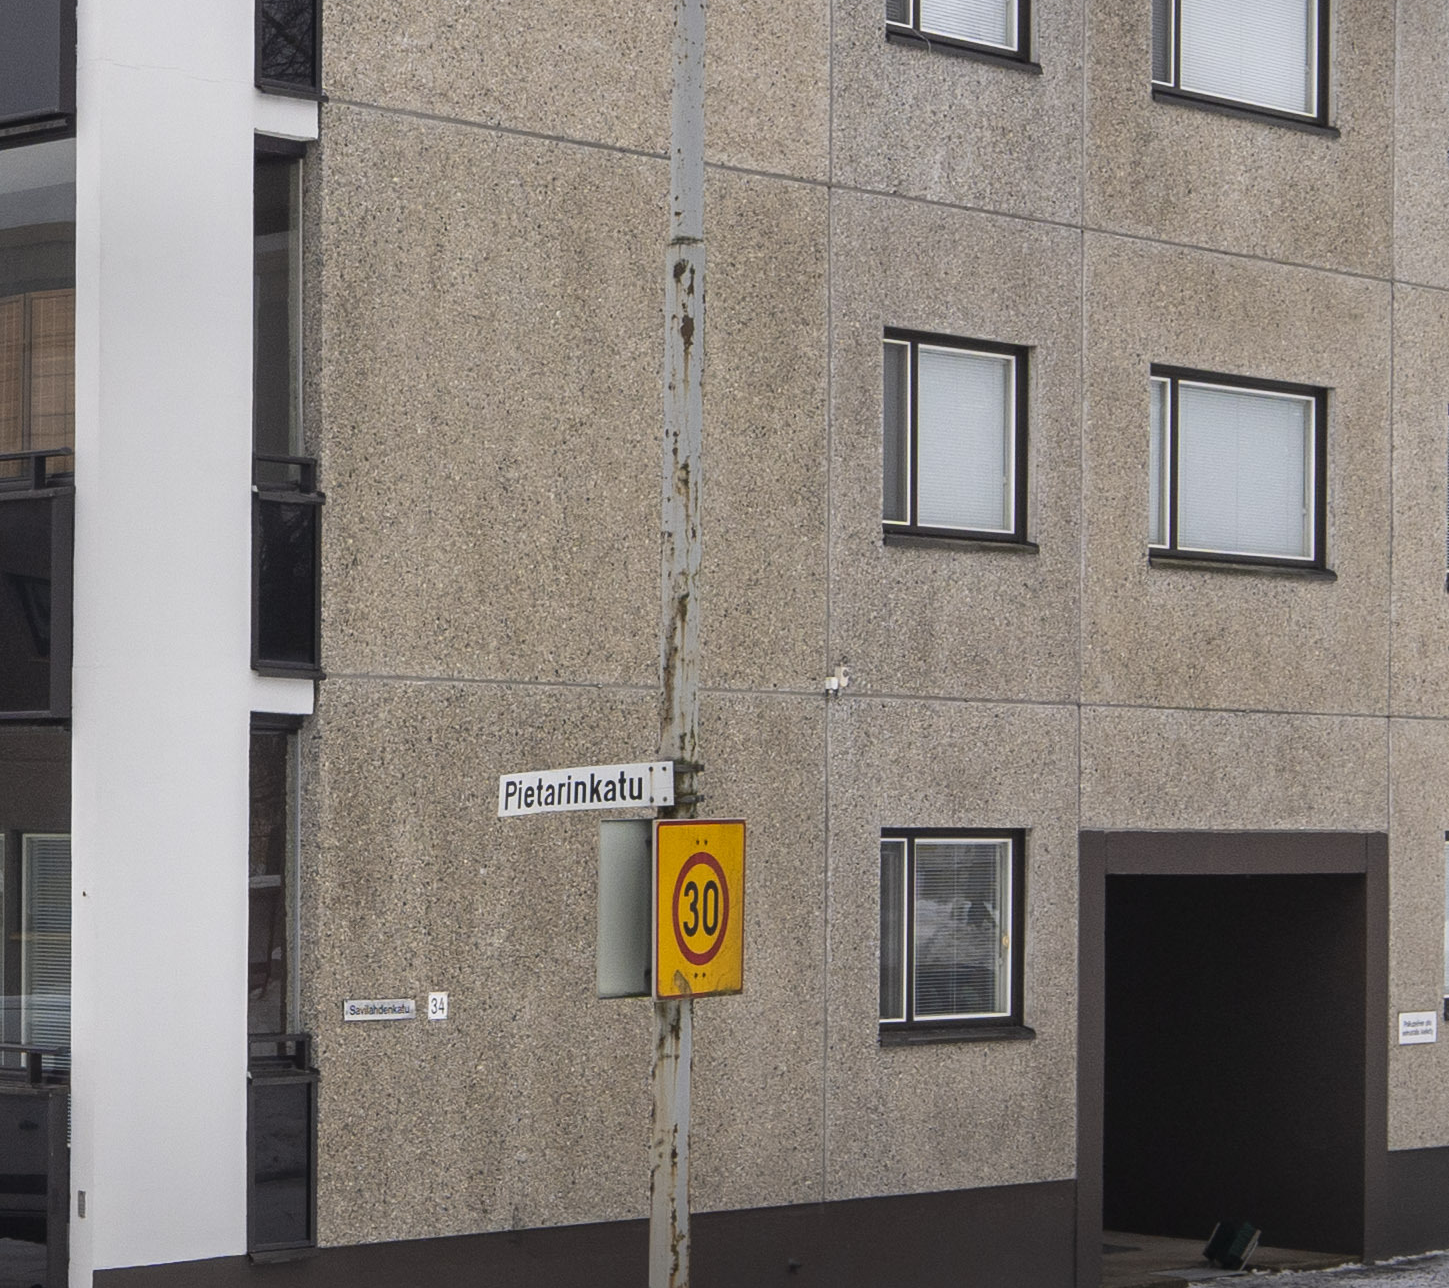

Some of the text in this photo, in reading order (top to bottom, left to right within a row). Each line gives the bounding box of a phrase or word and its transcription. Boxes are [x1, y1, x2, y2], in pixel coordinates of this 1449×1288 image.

[504, 770, 643, 811] Pietarinkatu
[683, 879, 719, 938] 30
[349, 997, 445, 1016] Savilahdenkatu 34
